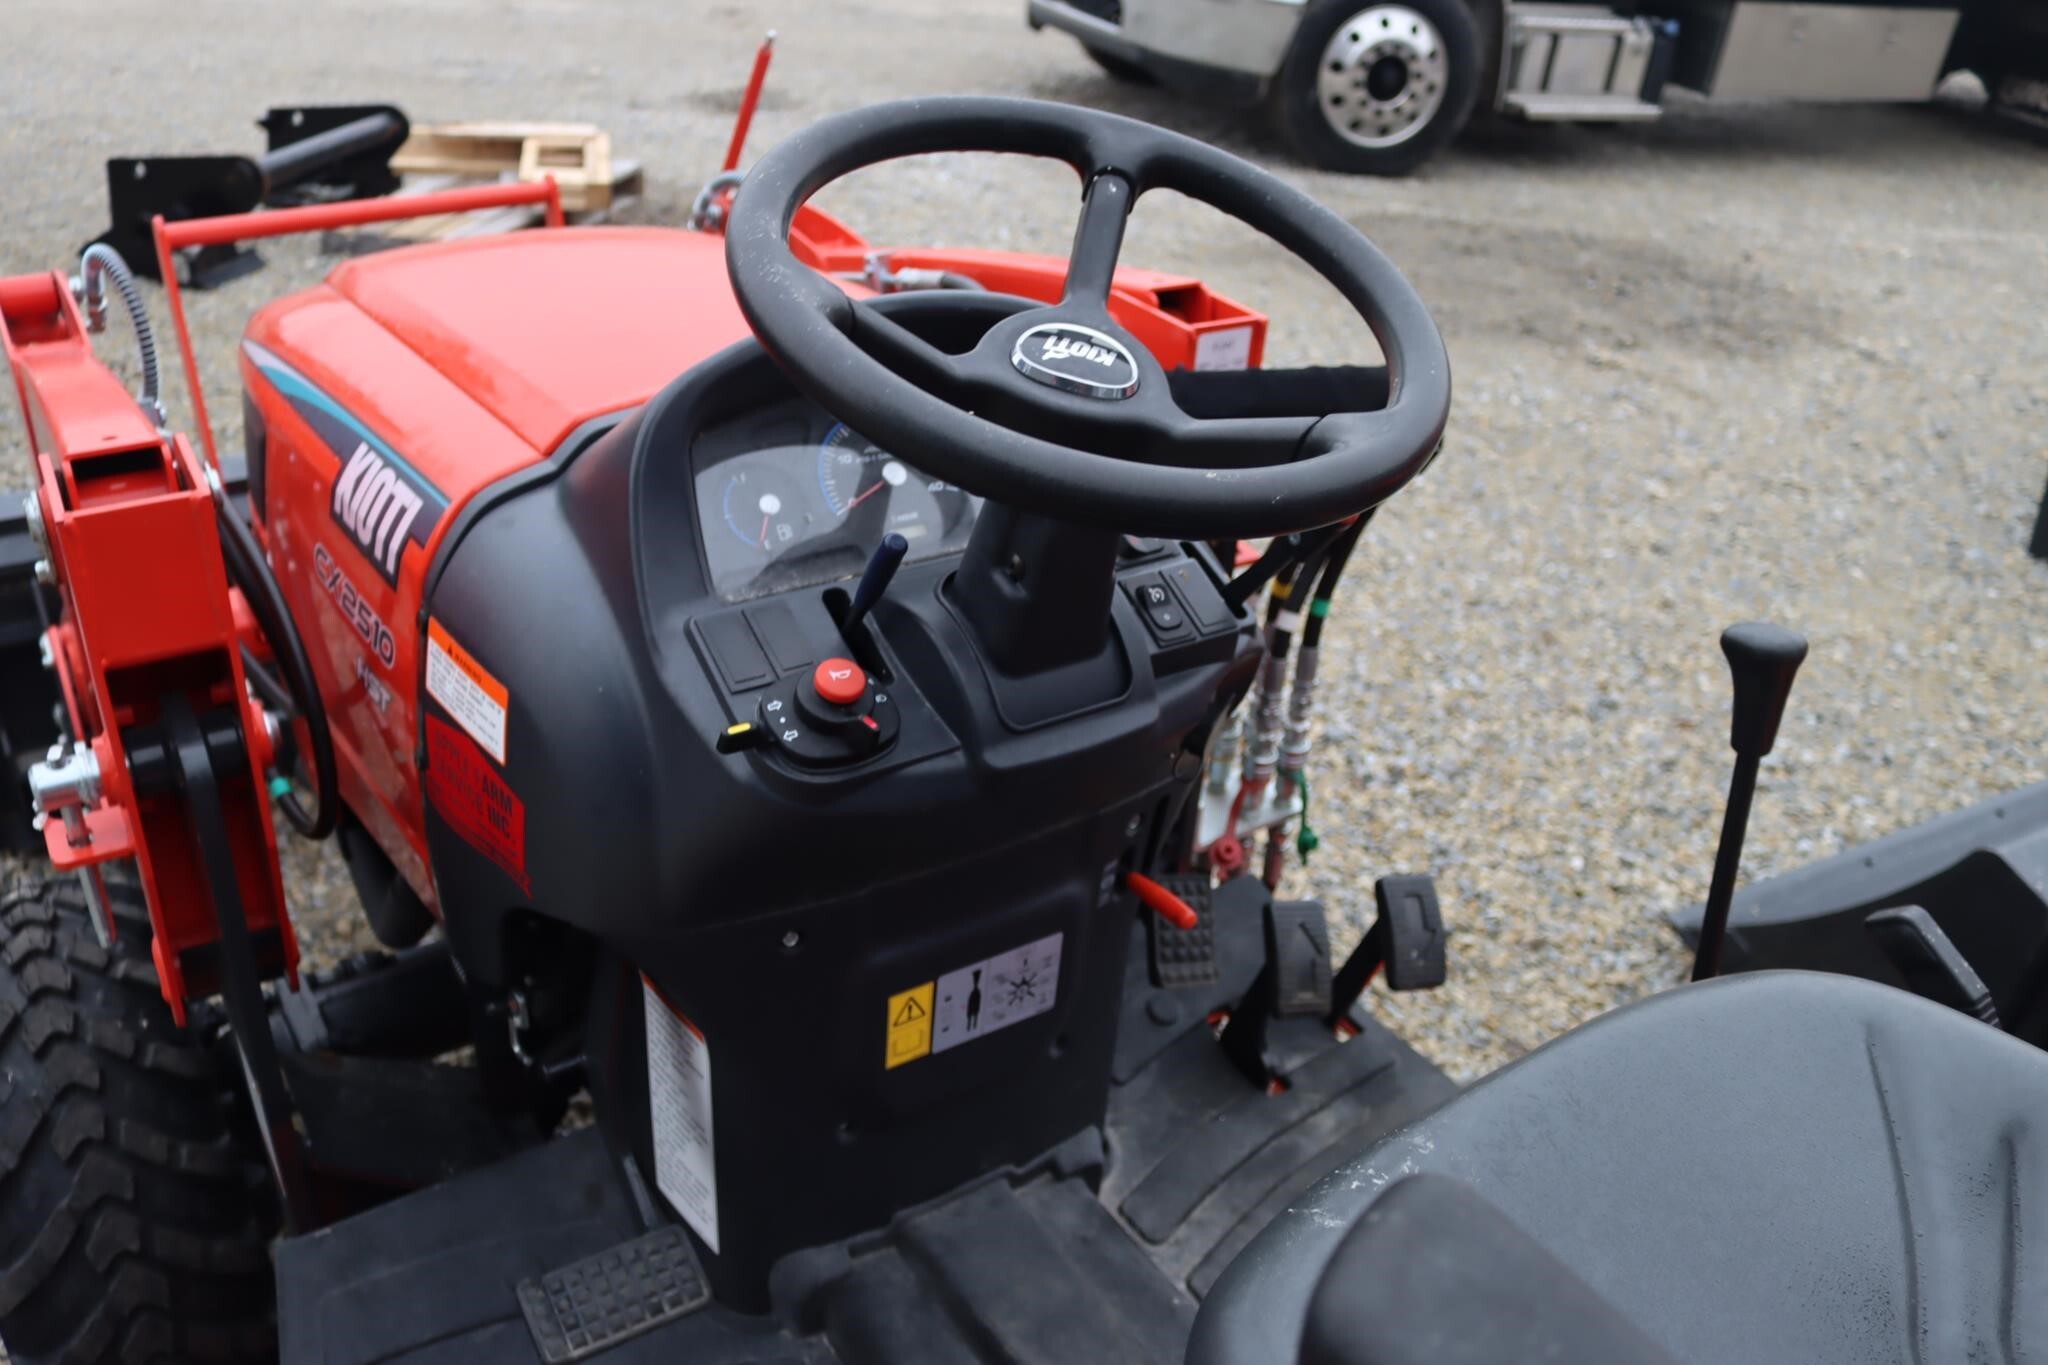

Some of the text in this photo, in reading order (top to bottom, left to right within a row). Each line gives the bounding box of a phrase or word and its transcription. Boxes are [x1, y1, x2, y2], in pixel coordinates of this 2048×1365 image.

[1041, 335, 1117, 367] KIOTI
[333, 441, 423, 575] KIOTI
[313, 542, 396, 669] CX2510
[355, 655, 393, 713] HST
